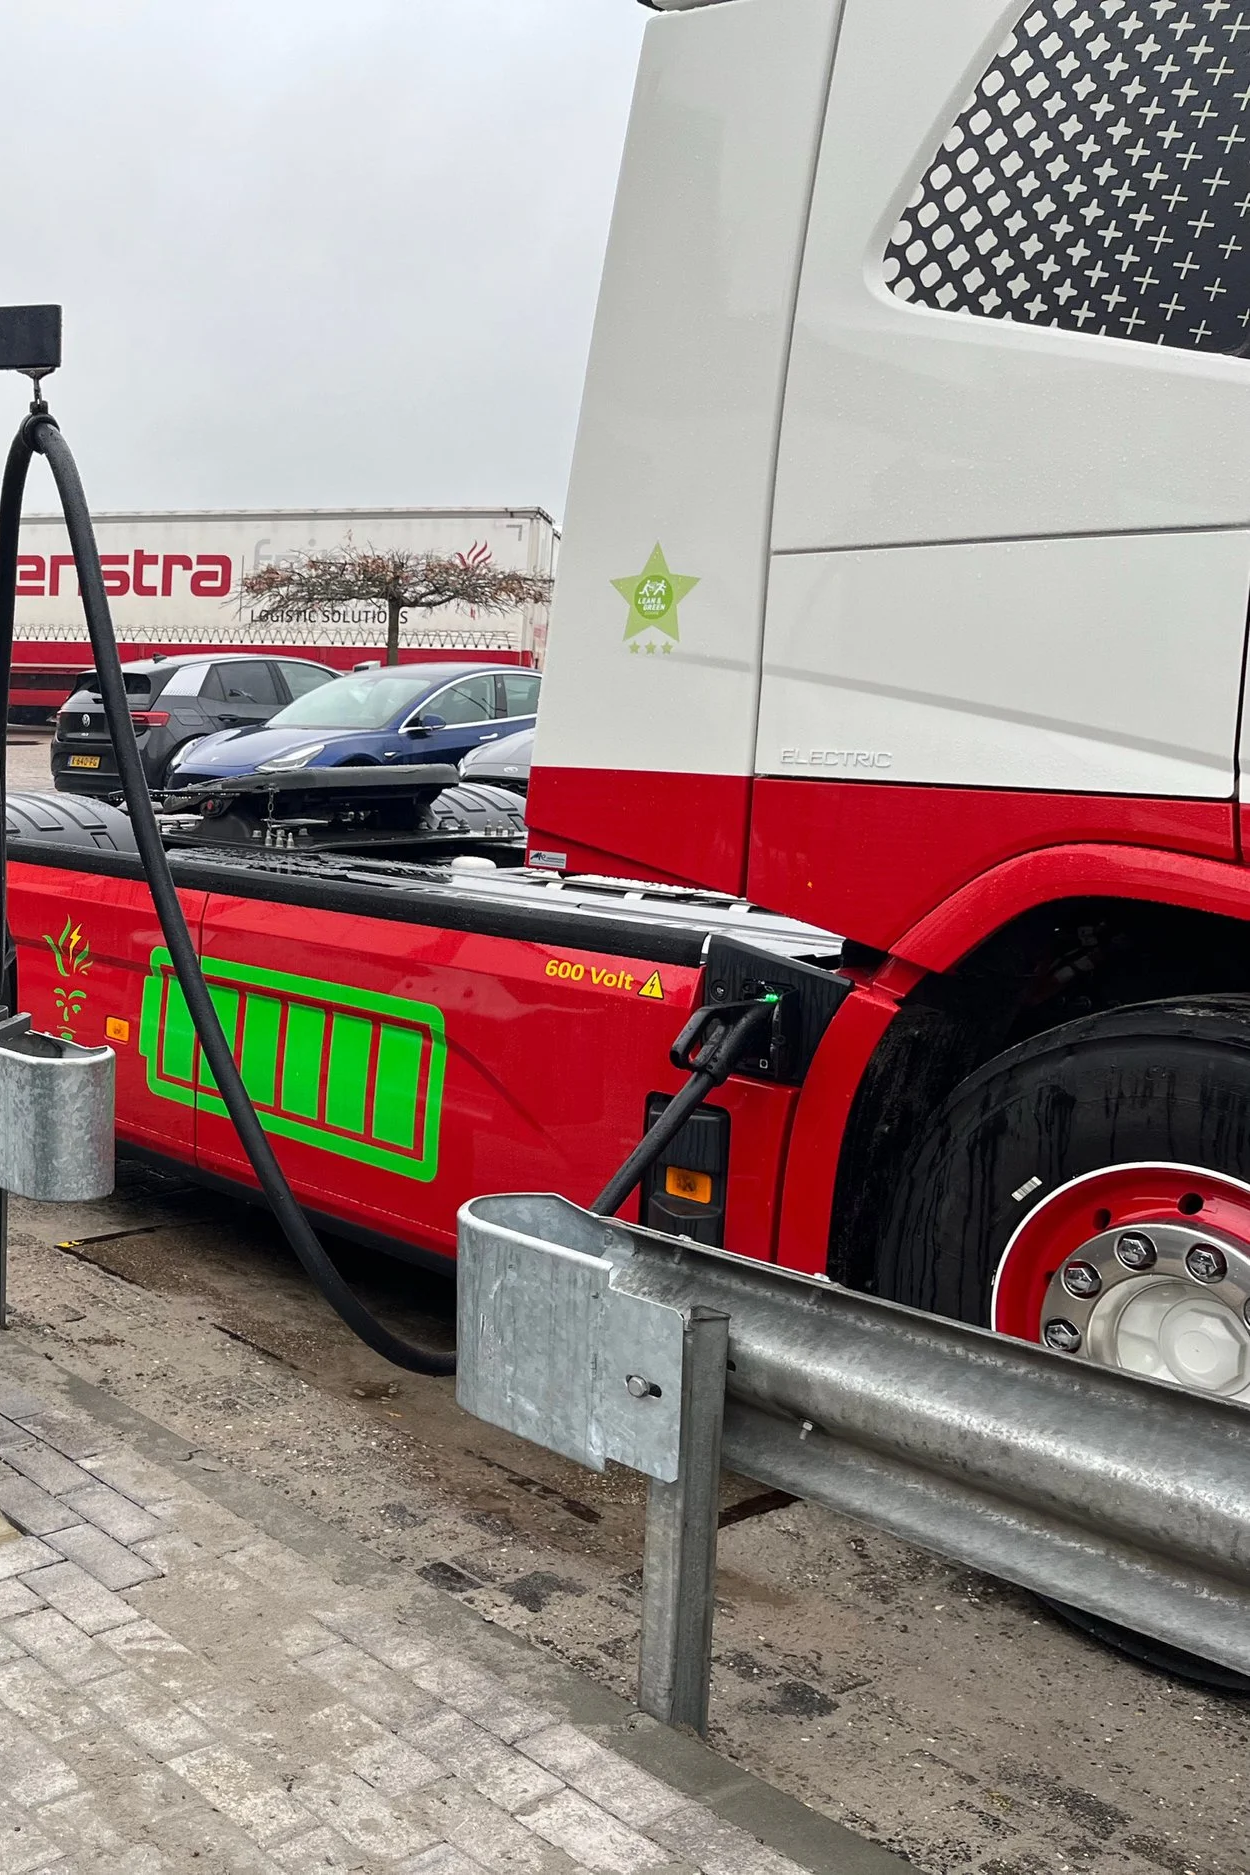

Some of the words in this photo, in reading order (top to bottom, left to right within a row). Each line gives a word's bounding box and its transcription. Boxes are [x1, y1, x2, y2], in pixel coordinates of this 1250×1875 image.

[251, 609, 317, 623] LOGISTIC
[321, 609, 409, 625] SOLUTIOS
[781, 748, 892, 768] ELECTRIC
[545, 959, 585, 981] 600
[591, 967, 634, 990] Volt
